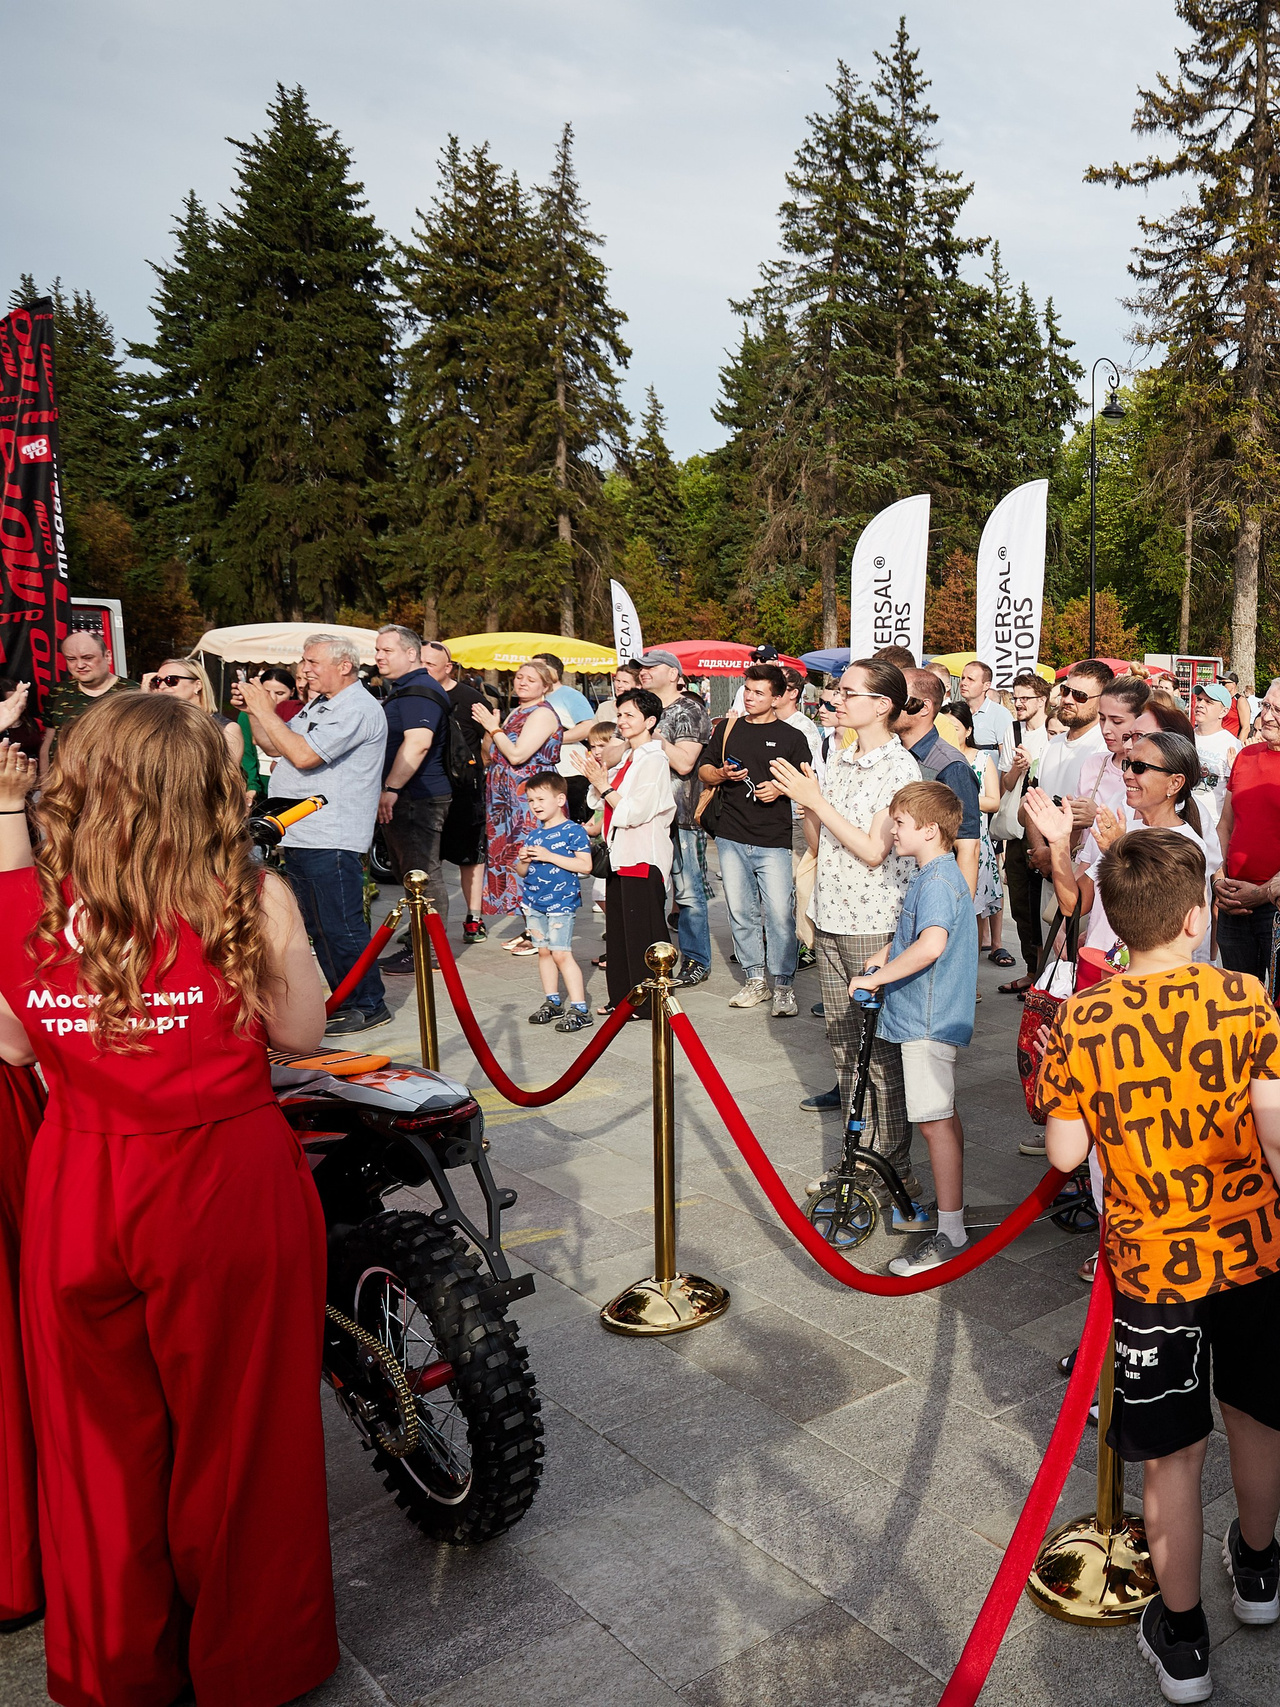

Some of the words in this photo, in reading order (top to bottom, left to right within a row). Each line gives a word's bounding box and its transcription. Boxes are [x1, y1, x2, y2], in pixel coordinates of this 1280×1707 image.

[0, 609, 44, 625] OTO
[873, 556, 892, 650] ERSAL®
[893, 602, 911, 649] ORS
[995, 546, 1013, 689] NIVERSAL®
[615, 602, 632, 665] РСАЛ®
[1013, 597, 1035, 678] OTORS
[560, 656, 614, 666] укуруза
[26, 986, 204, 1009] Москский
[41, 1015, 189, 1036] трапорт
